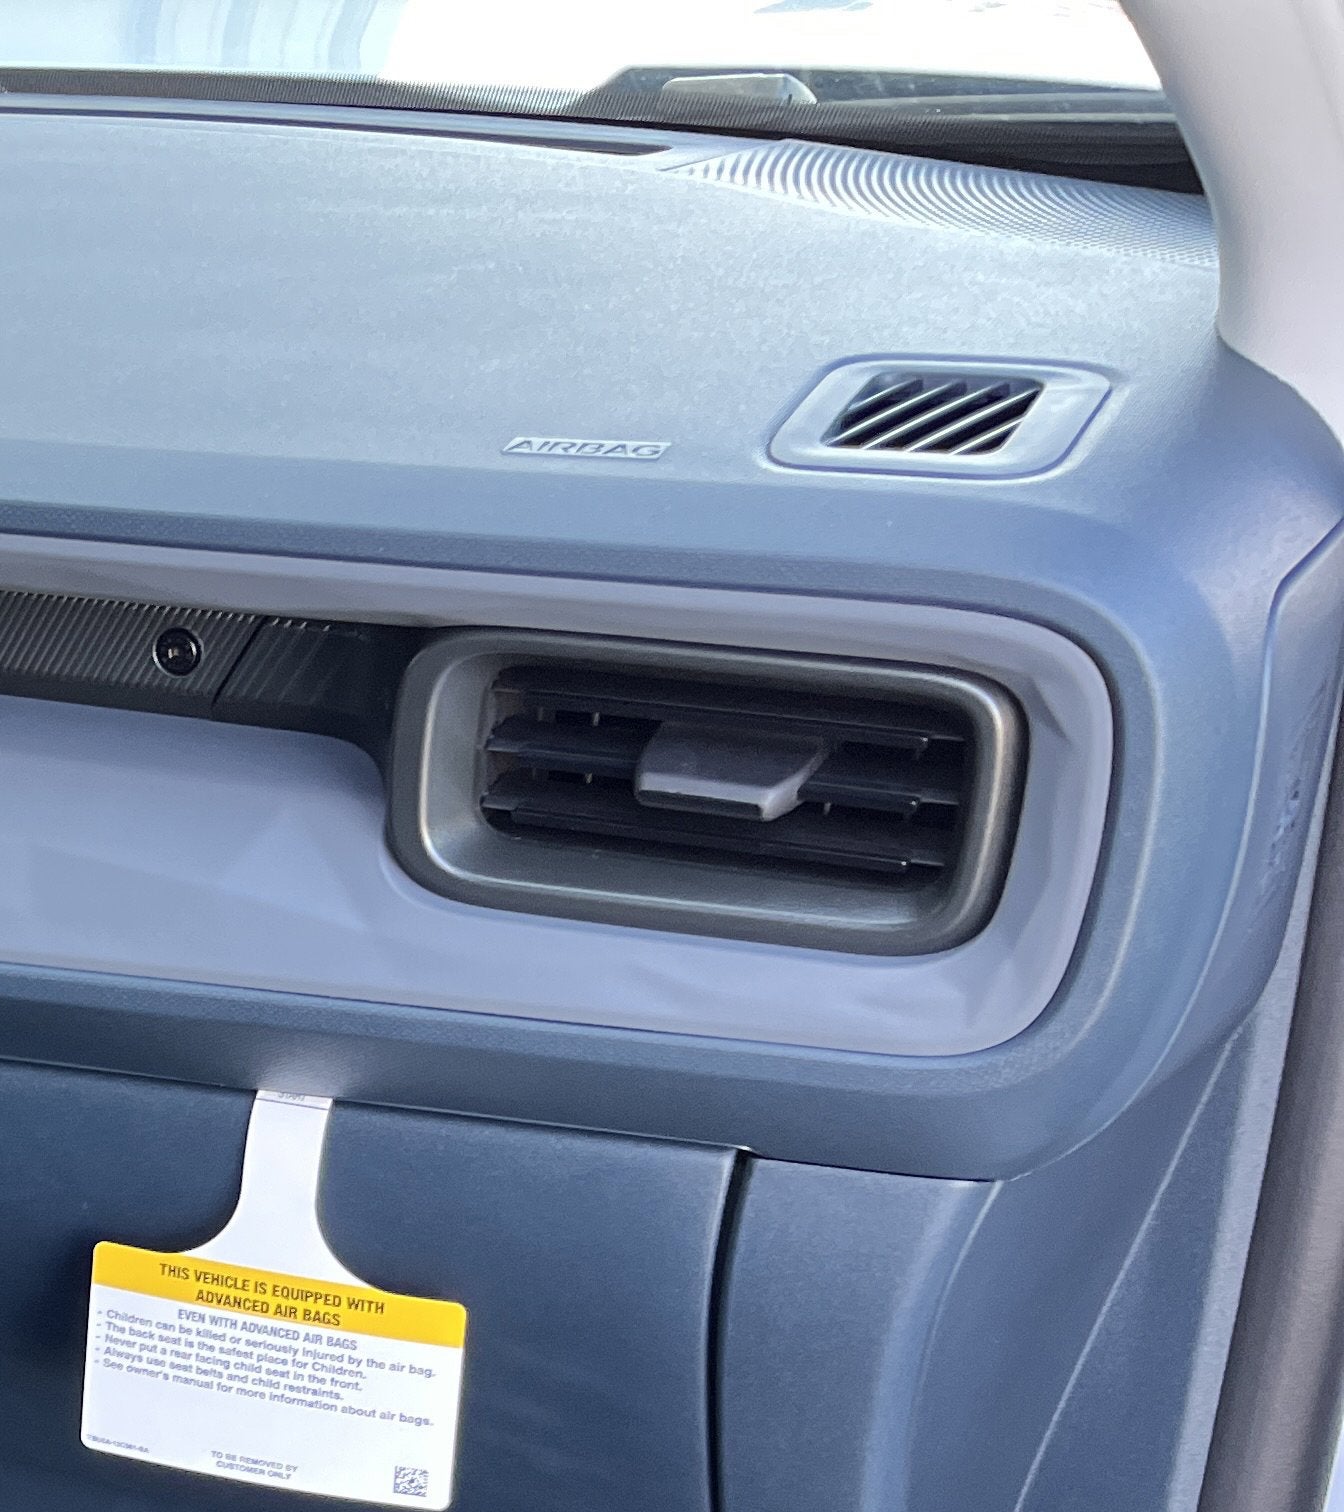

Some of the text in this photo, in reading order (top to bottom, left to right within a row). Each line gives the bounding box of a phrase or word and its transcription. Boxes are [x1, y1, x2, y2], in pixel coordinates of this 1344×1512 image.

[507, 440, 661, 457] AIRBAG
[160, 1263, 385, 1314] THIS VEHICLE IS EQUIPPED WITH
[196, 1289, 341, 1326] ADVANCED AIR BAGS
[105, 1321, 367, 1380] The back seat is the safest place for Children.
[106, 1309, 152, 1327] Children
[155, 1321, 176, 1333] can
[179, 1324, 193, 1336] be
[195, 1327, 226, 1342] killed
[229, 1336, 242, 1345] or
[245, 1338, 299, 1357] seriously
[347, 1354, 363, 1368] by
[366, 1358, 386, 1370] the
[389, 1362, 406, 1372] air
[408, 1364, 436, 1379] bag.
[177, 1309, 358, 1351] EVEN WITH ADVANCED AIR BAGS
[103, 1346, 344, 1401] Always use seat belts and child restraints.
[104, 1334, 363, 1391] Never put a rear facing child seat in the front.
[102, 1357, 435, 1427] See owner's manual for more information about air bags.
